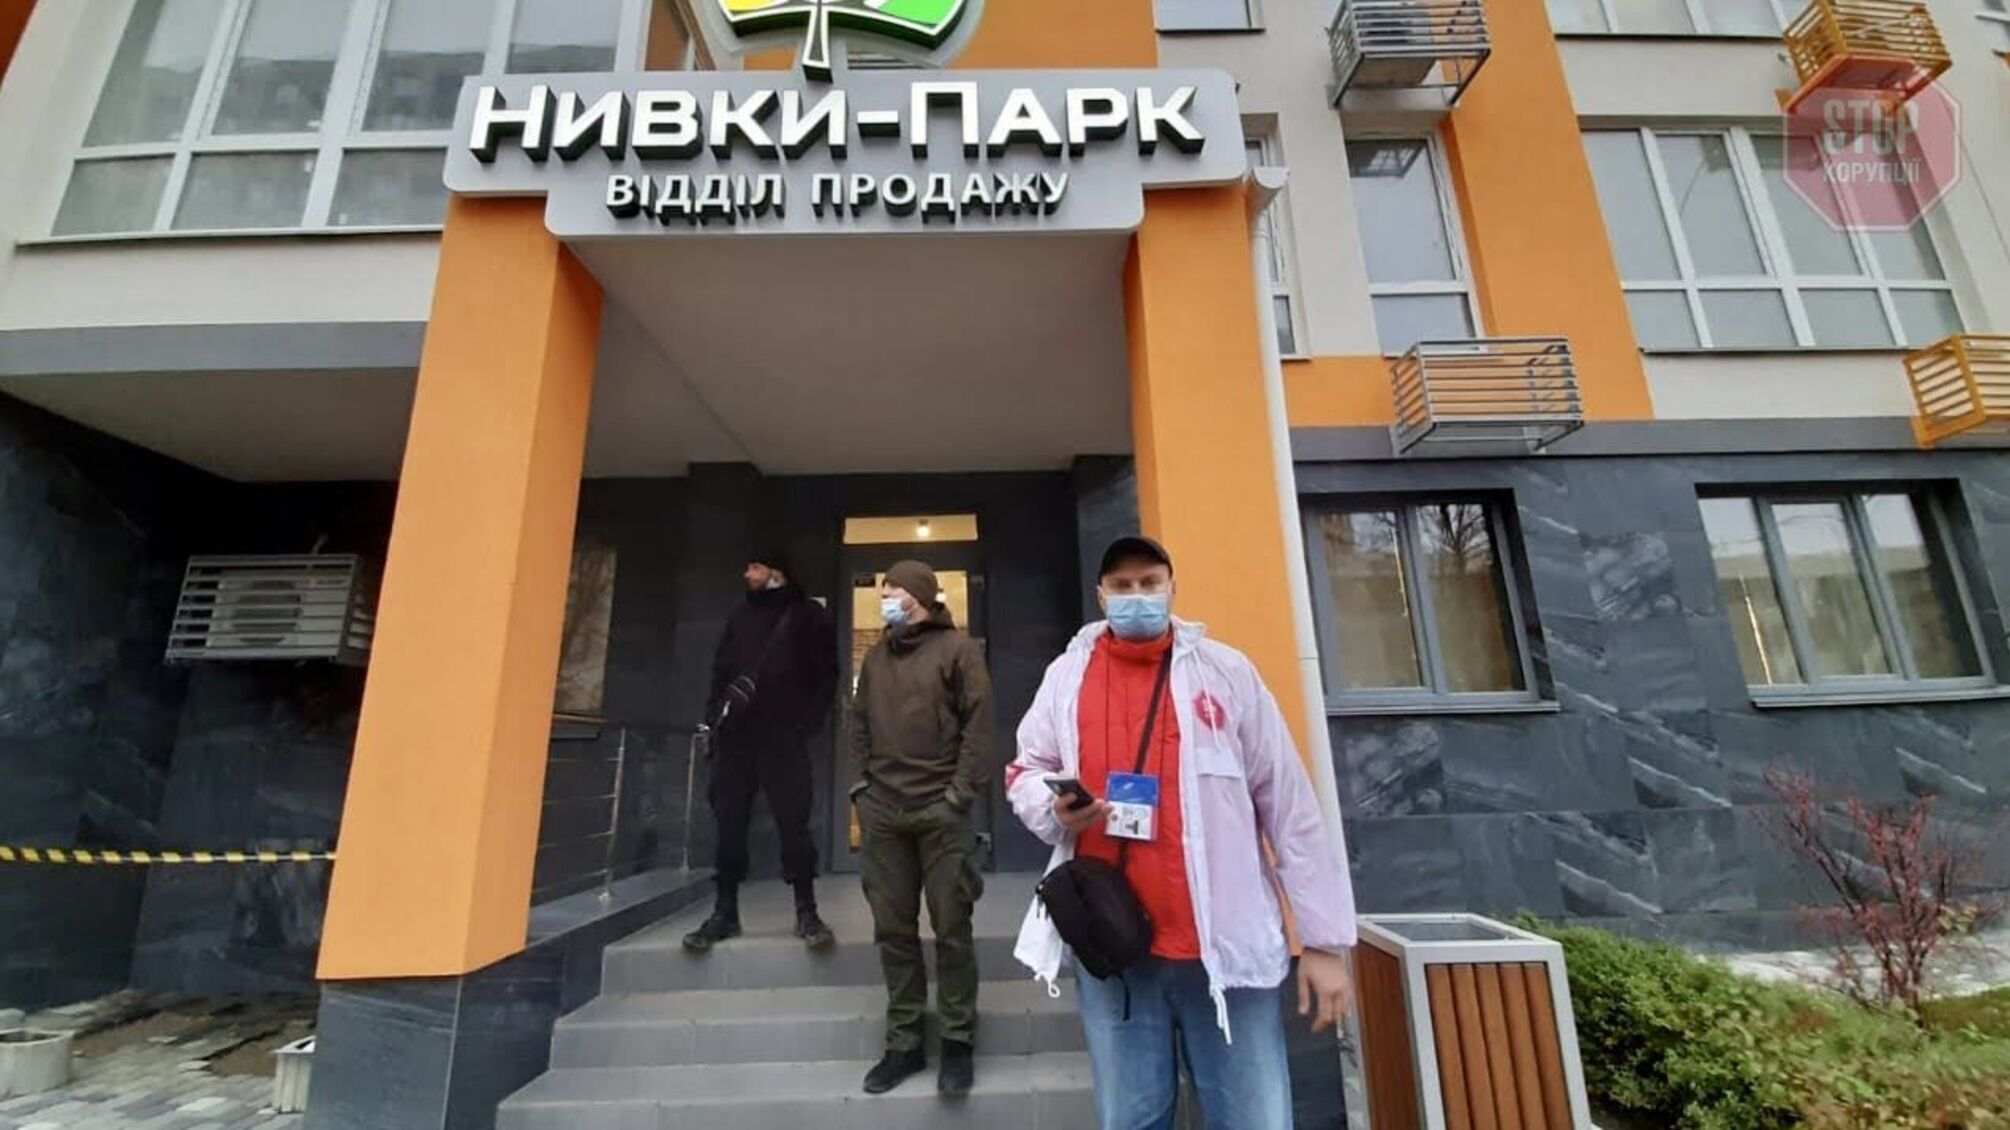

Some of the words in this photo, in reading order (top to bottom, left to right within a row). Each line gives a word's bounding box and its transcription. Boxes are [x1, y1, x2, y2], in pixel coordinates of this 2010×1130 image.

[469, 81, 1205, 162] НИВКИ-ПАРК
[605, 173, 787, 227] ВІДДІЛ
[811, 171, 1069, 225] ПРОДАЖУ
